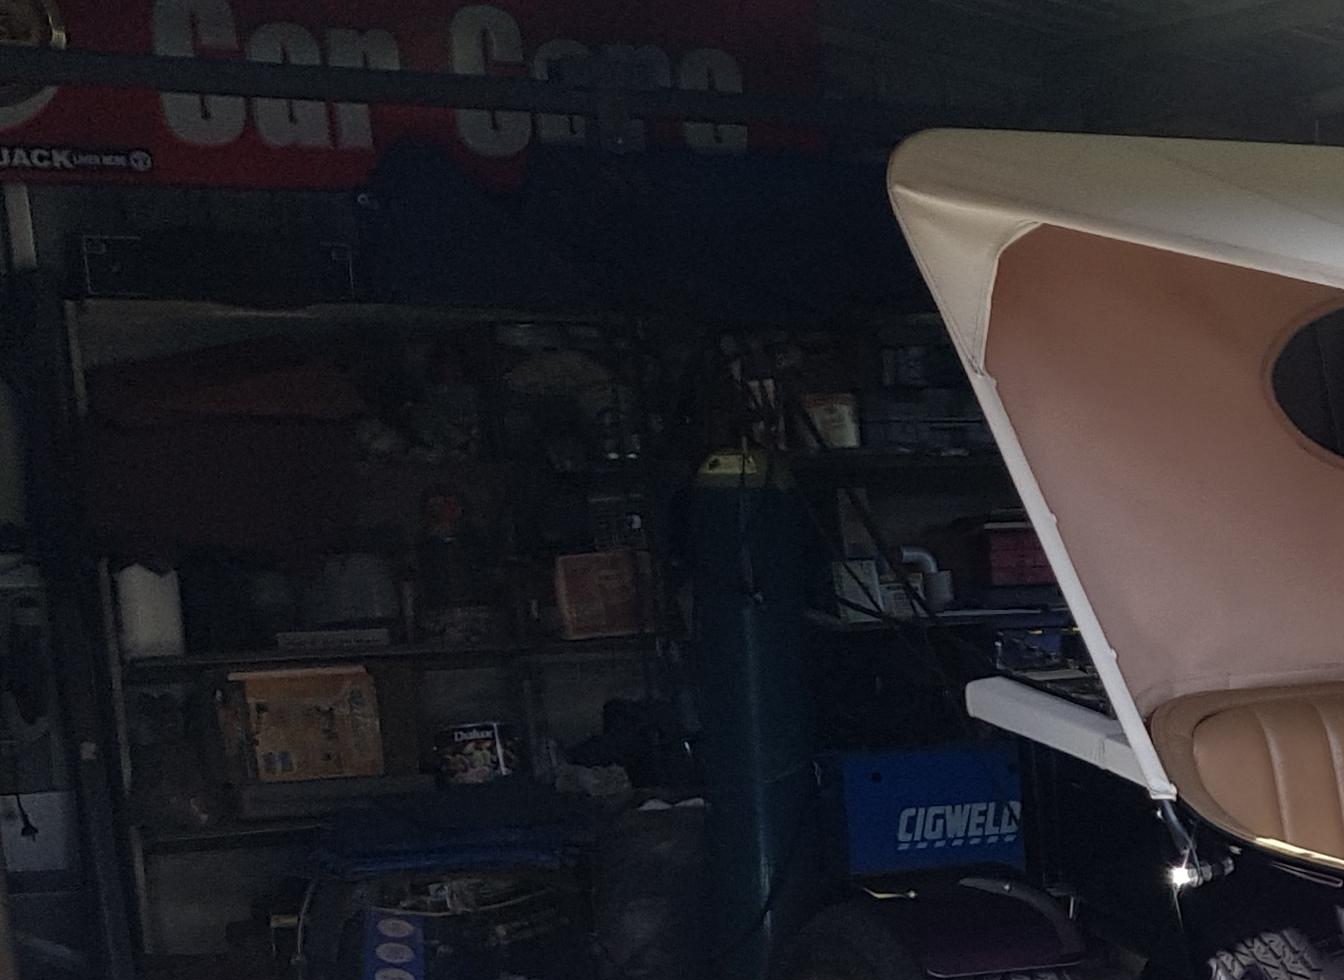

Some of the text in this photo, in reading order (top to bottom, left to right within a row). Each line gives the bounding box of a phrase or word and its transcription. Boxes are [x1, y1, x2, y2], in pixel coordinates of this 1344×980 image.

[153, 0, 402, 148] Car
[0, 147, 76, 168] JACK
[897, 801, 1021, 842] CIGWELD
